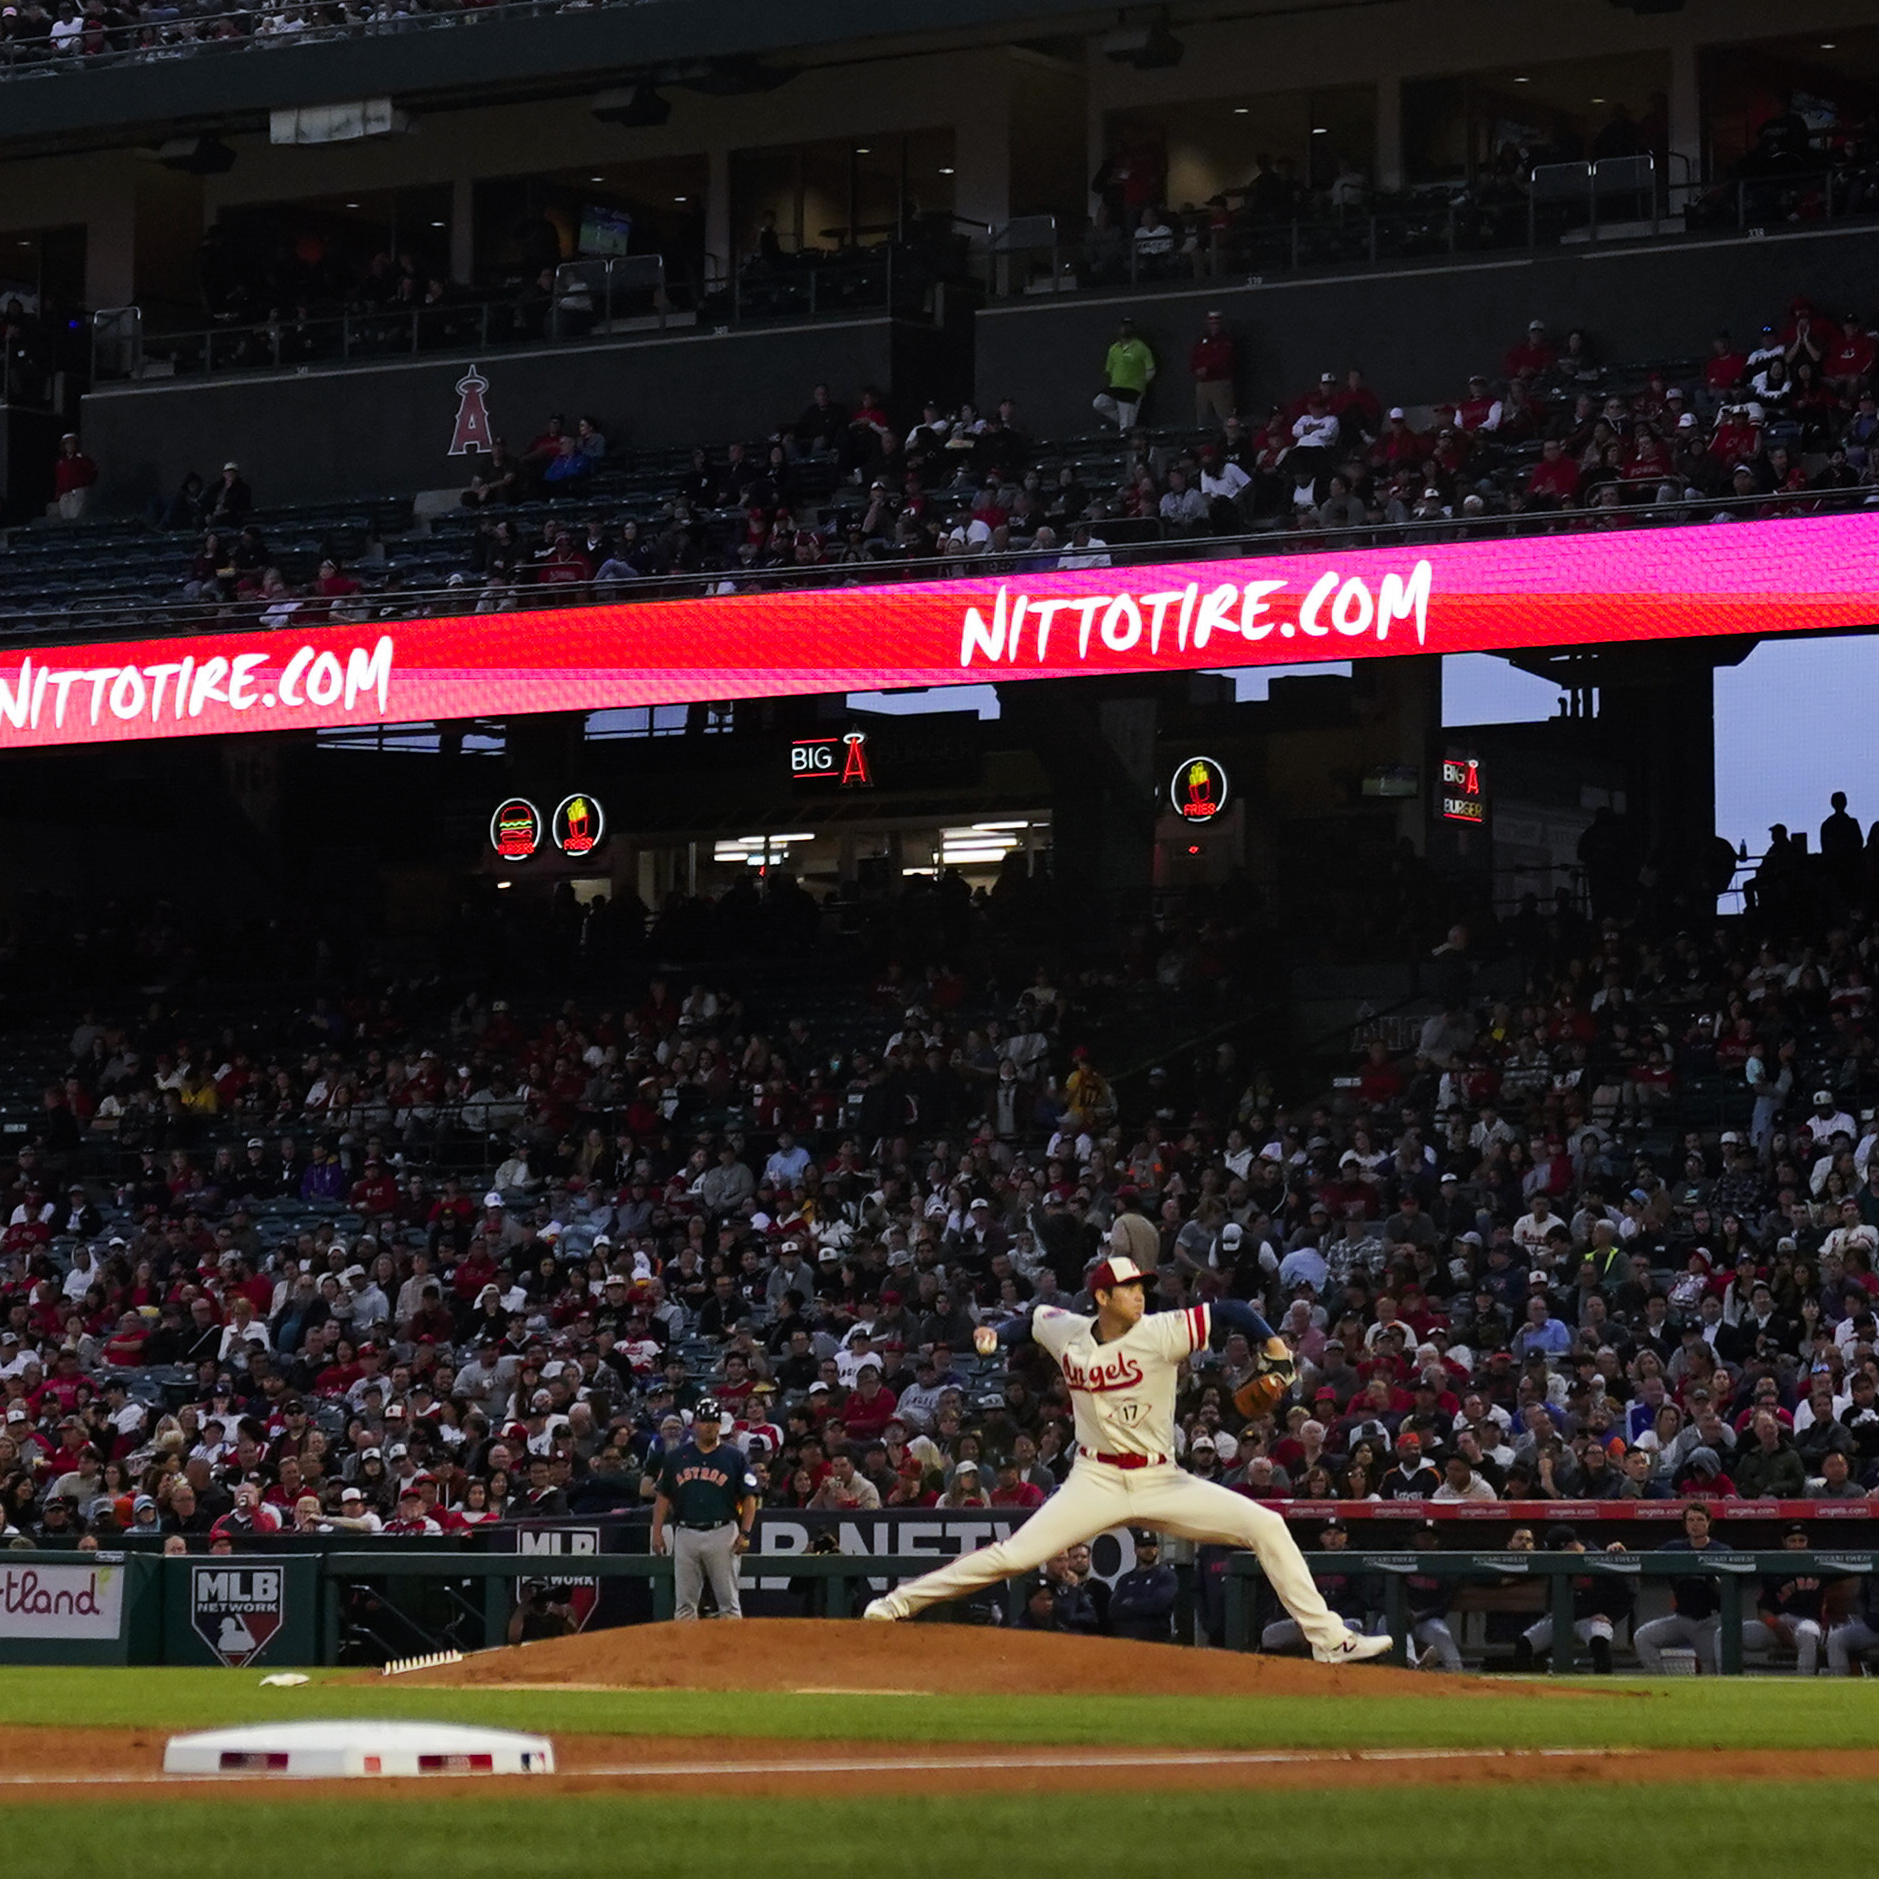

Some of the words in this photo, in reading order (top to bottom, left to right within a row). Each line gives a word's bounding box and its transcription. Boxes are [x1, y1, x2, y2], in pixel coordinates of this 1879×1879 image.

[961, 560, 1432, 666] NITTOTIRE.COM
[791, 746, 833, 772] BIG
[841, 731, 868, 785] A
[1443, 763, 1465, 784] BIG
[1183, 803, 1217, 817] FRIES
[1444, 797, 1484, 818] BURGER
[563, 836, 595, 852] FRIES
[1062, 1351, 1143, 1392] Angels
[1123, 1405, 1138, 1421] 17
[196, 1570, 279, 1603] MLB
[196, 1603, 279, 1614] NETWORK
